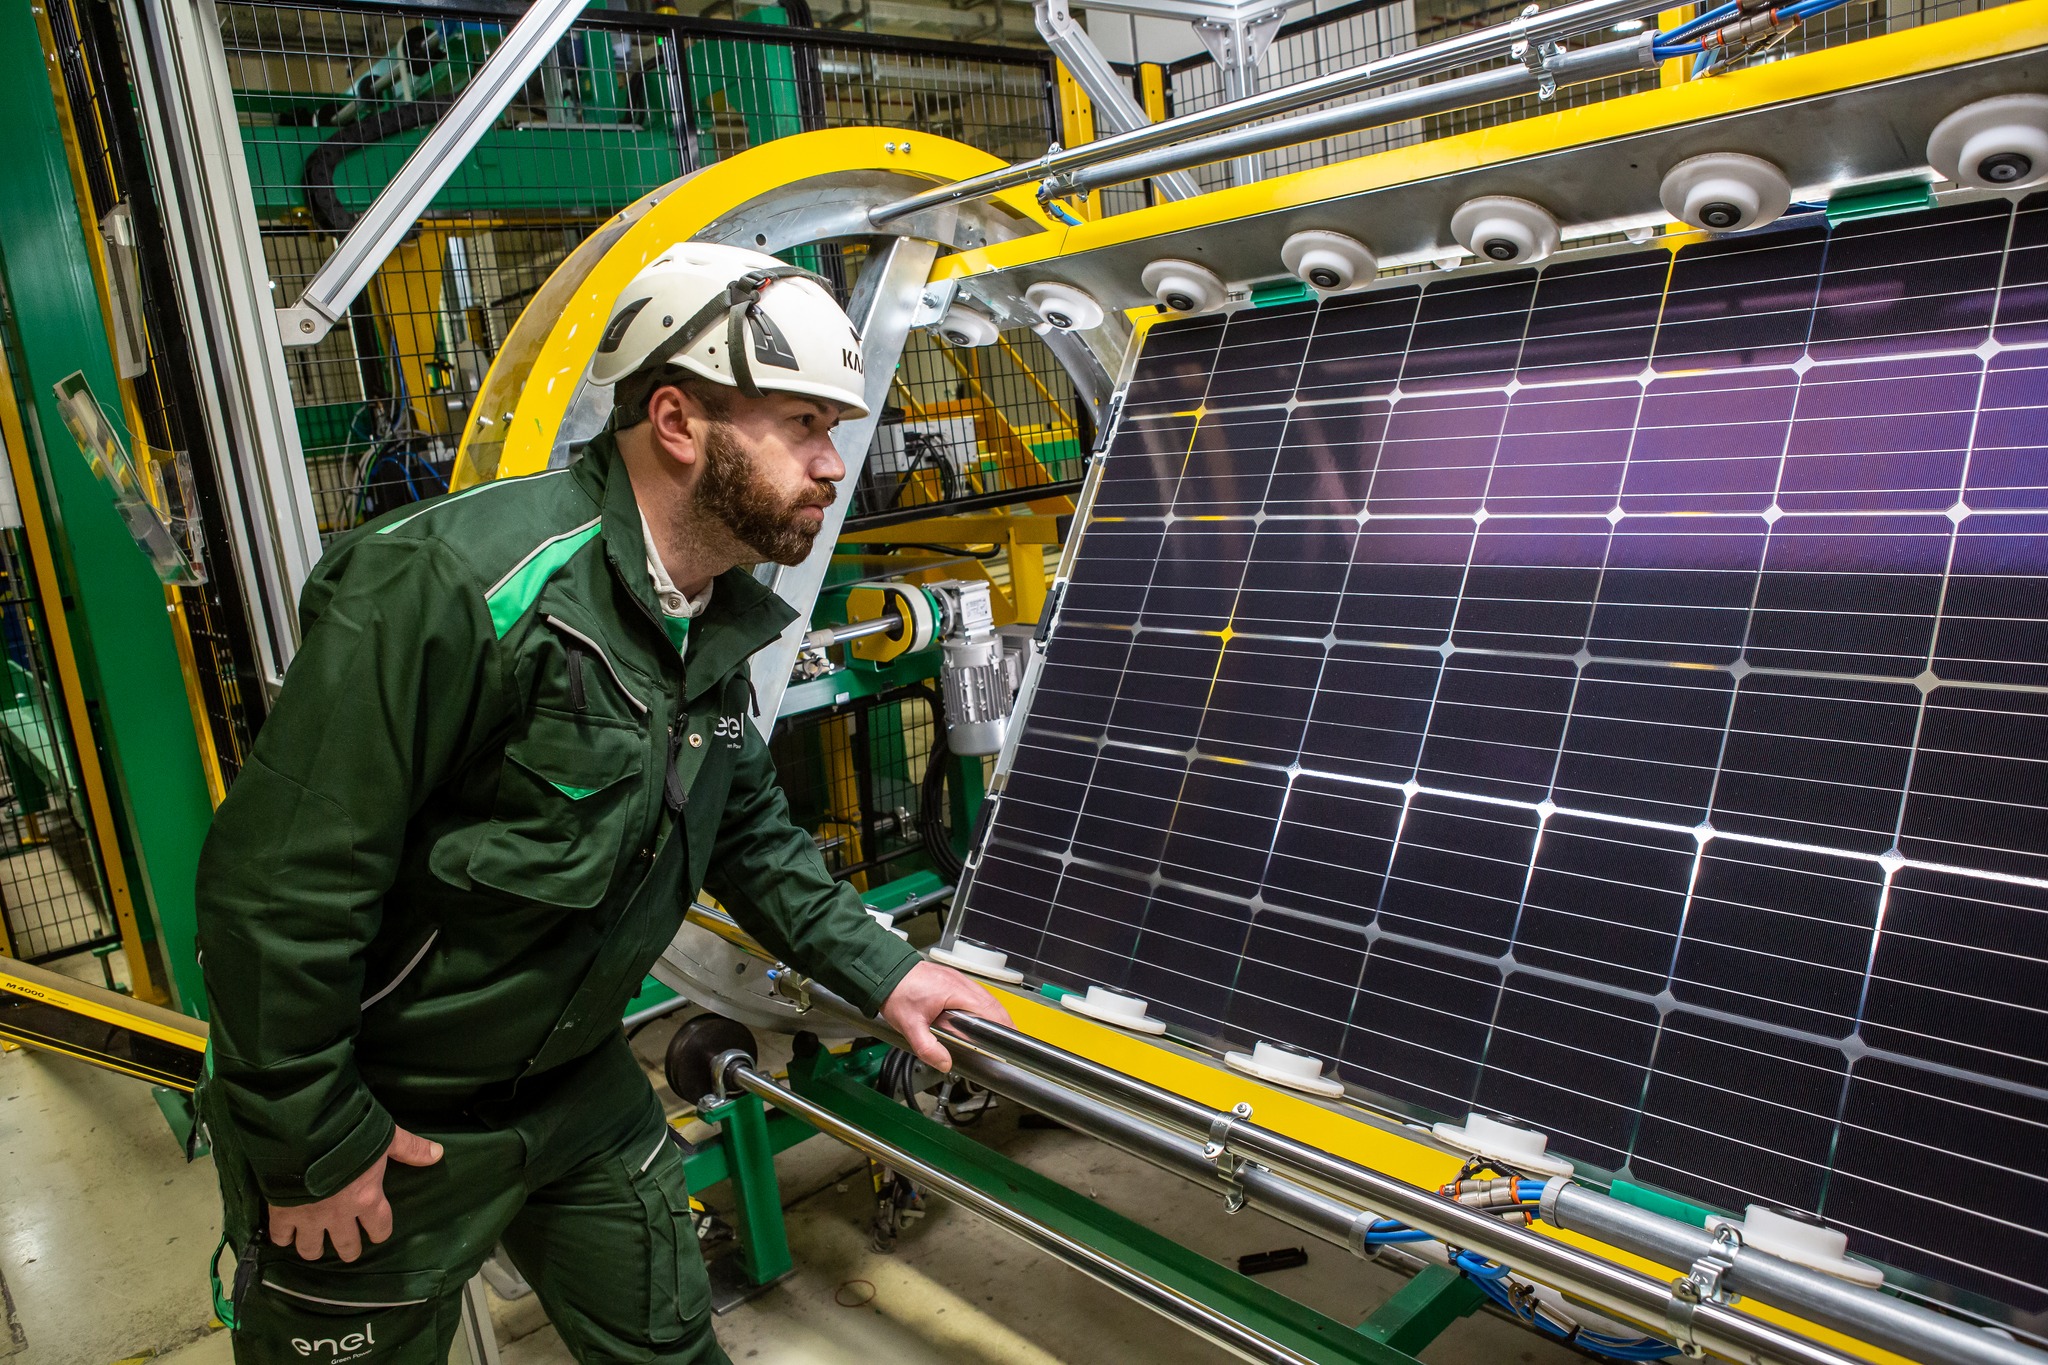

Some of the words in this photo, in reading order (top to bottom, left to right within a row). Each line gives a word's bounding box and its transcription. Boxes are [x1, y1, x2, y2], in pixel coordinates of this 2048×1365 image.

[291, 1322, 375, 1356] enel
[331, 1356, 352, 1365] Green
[352, 1348, 373, 1359] Power
